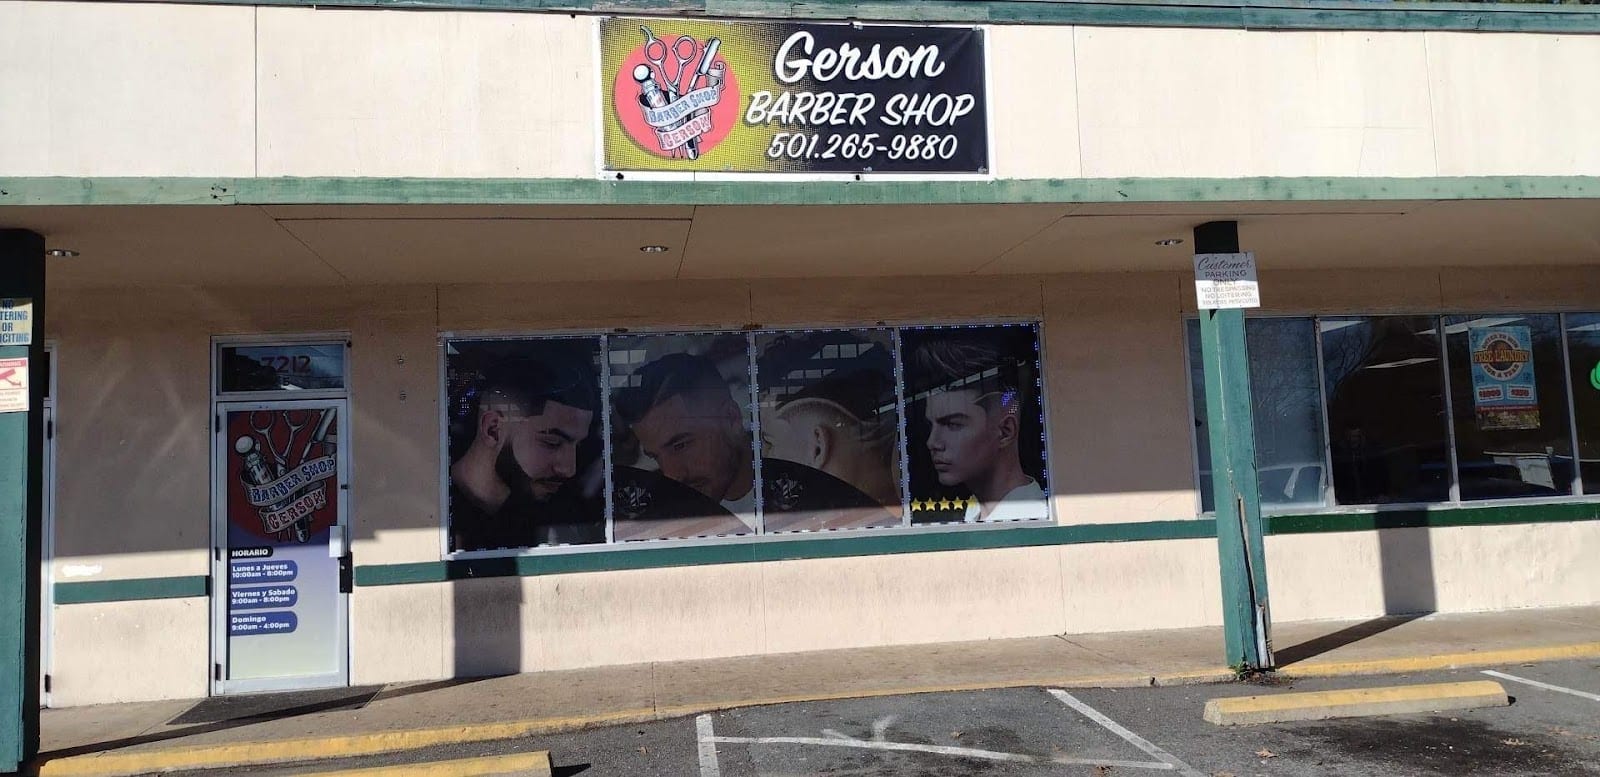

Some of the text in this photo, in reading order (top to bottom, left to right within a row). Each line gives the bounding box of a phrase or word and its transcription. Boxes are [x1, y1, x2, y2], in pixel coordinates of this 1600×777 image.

[774, 31, 946, 83] Gerson
[649, 89, 717, 123] BARBER SHOP
[745, 91, 975, 127] BARBER SHOP
[663, 116, 711, 147] GERSON
[767, 133, 958, 161] 501.265-9880
[1198, 256, 1252, 270] Customer
[1205, 269, 1247, 278] PARKING
[1212, 278, 1238, 286] ONLY
[2, 322, 13, 332] OR
[1474, 350, 1529, 362] FREE LAUNDRY
[251, 459, 335, 503] BARBER SHOP
[268, 492, 326, 529] GERSON
[232, 549, 268, 557] HORARIO
[232, 590, 260, 598] Viernes
[268, 588, 295, 596] Sabado
[232, 616, 266, 624] Domingo
